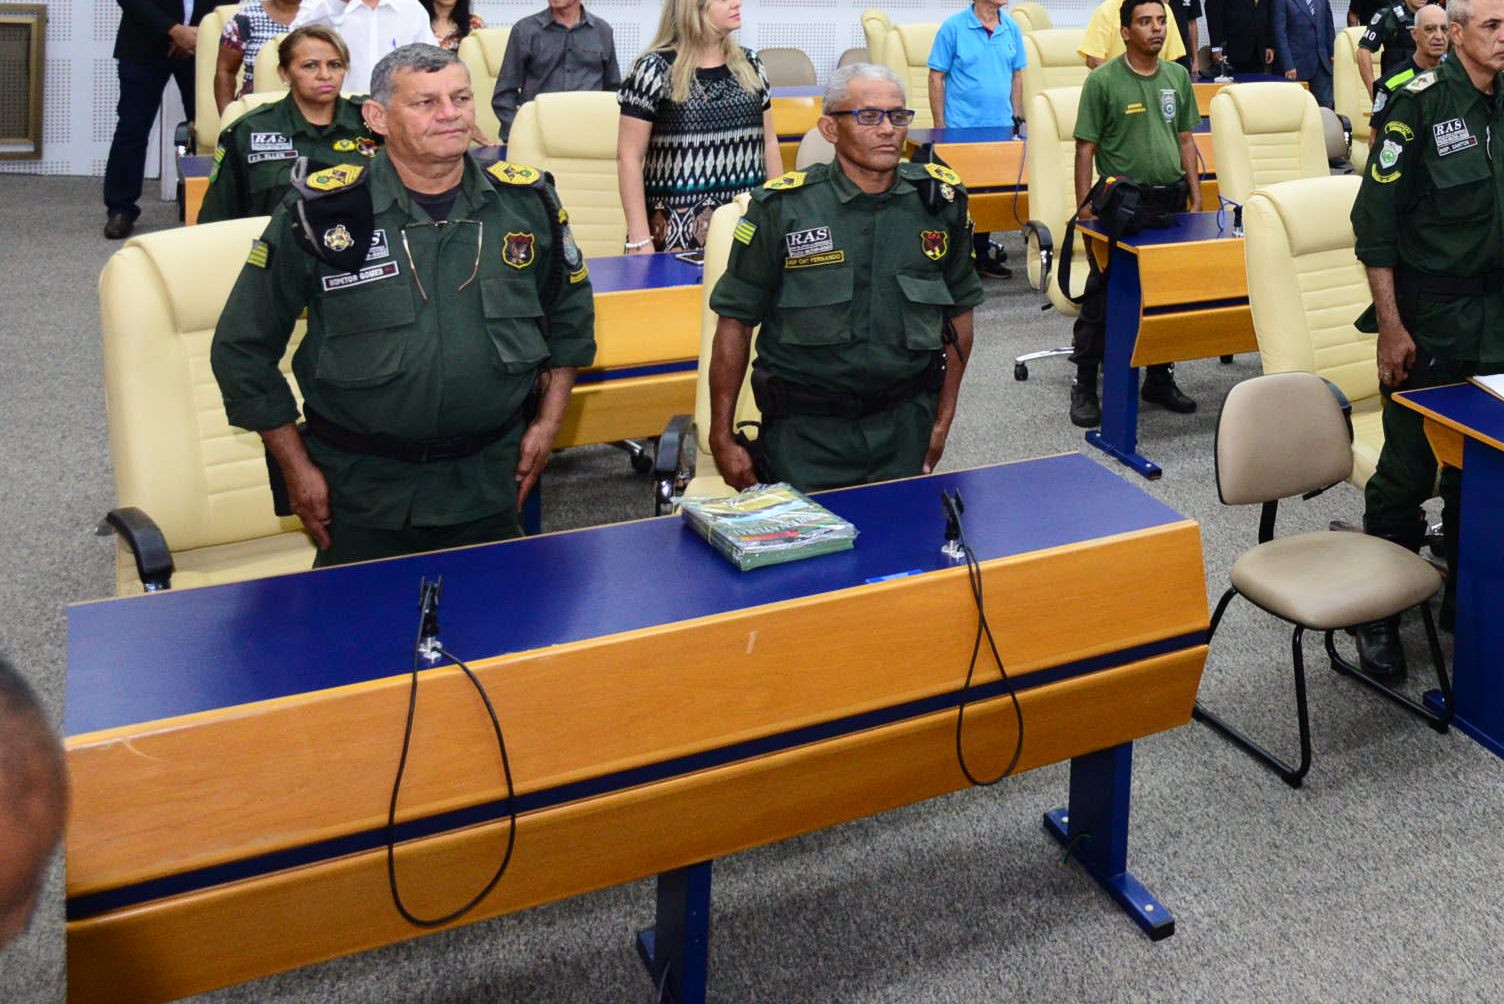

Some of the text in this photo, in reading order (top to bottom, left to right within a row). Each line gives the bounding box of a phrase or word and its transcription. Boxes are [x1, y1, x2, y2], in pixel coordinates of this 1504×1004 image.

[1436, 120, 1462, 136] RAS
[255, 135, 287, 143] RAS
[790, 228, 828, 245] RAS
